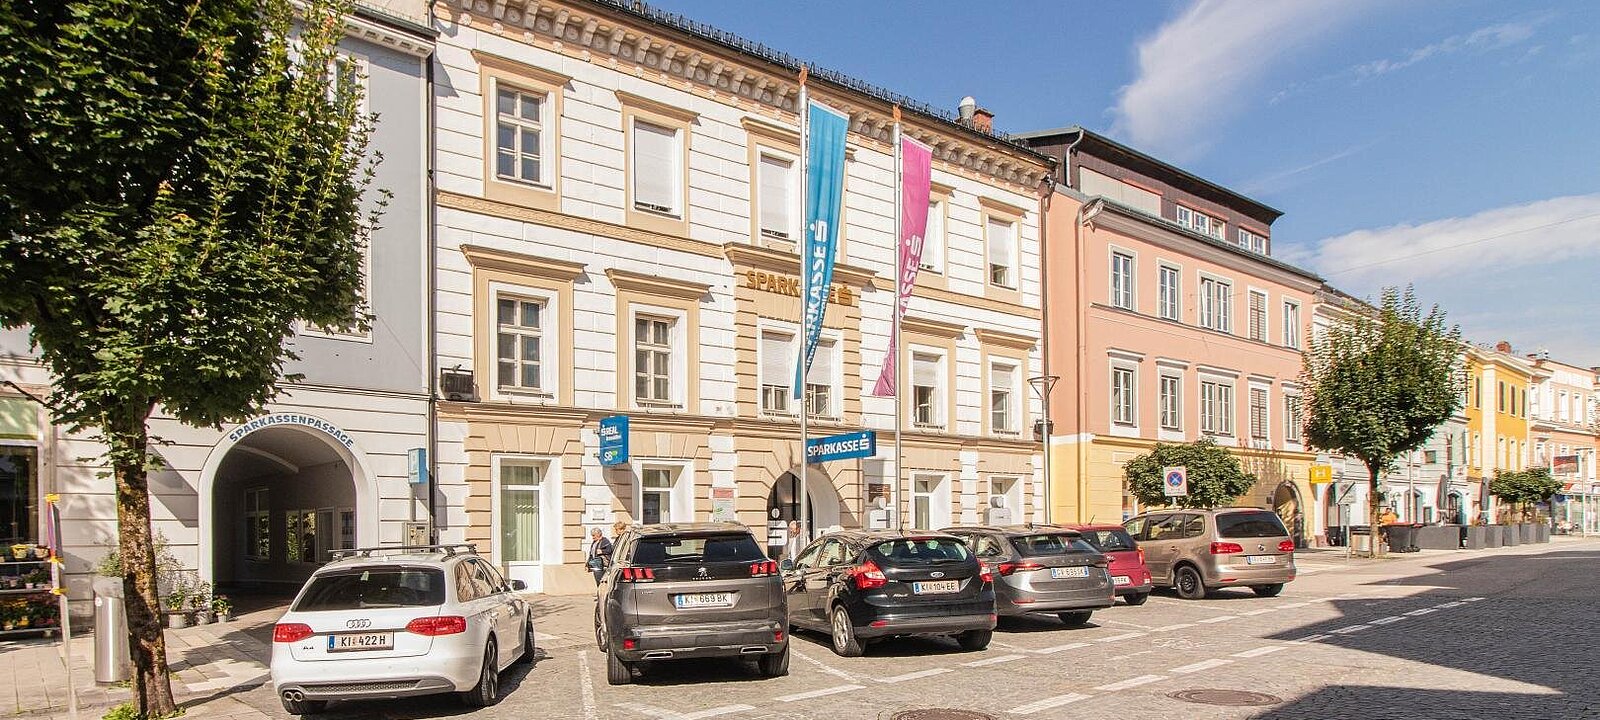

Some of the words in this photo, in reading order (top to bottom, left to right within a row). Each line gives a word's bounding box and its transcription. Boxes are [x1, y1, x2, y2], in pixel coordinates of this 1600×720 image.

[746, 270, 837, 304] SPARKE
[805, 244, 827, 346] ARKASSE
[229, 414, 354, 448] SPARKASSENPASSAGE
[807, 439, 859, 457] SPARKASSE
[699, 593, 716, 603] 669
[340, 636, 351, 647] KI
[358, 635, 378, 646] 422
[379, 635, 386, 646] H
